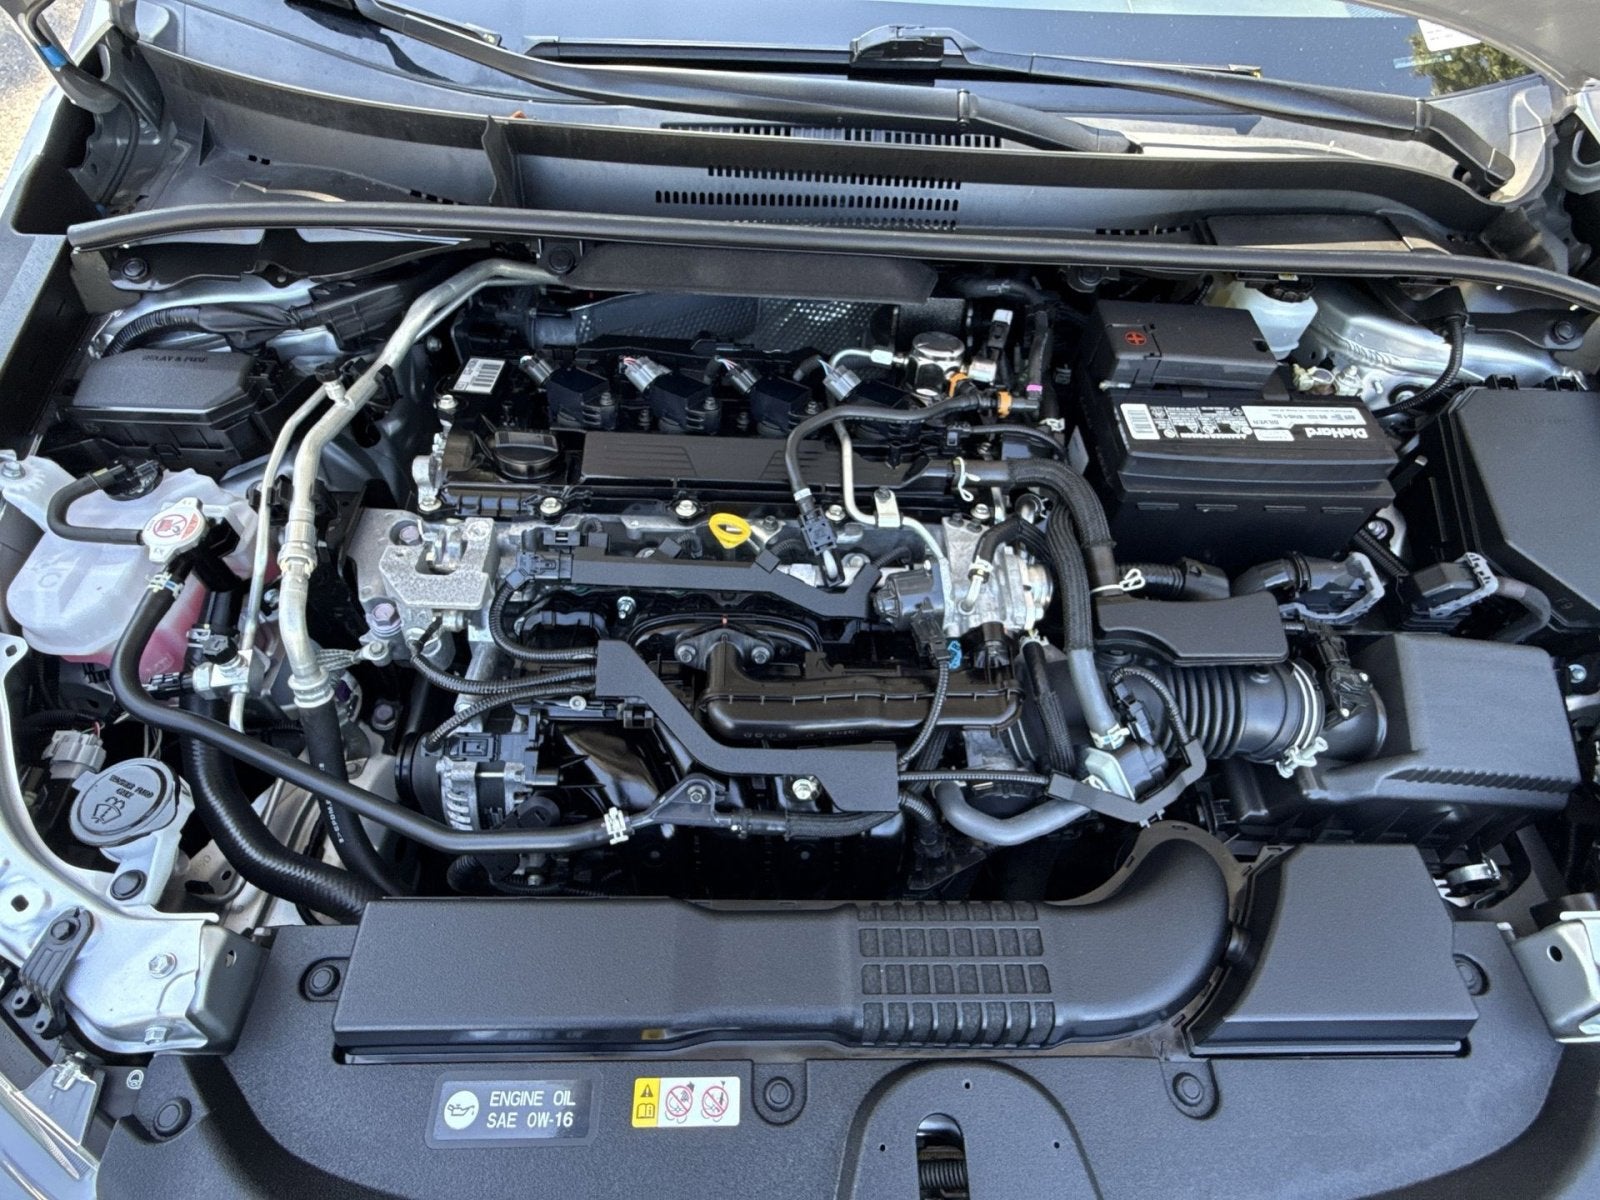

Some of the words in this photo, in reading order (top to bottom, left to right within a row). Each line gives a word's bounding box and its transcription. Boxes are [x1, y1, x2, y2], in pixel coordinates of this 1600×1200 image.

[1304, 427, 1369, 439] DieHard
[489, 1090, 545, 1107] ENGINE
[553, 1090, 577, 1106] OIL
[486, 1112, 518, 1129] SAE
[526, 1111, 575, 1128] 0W-16
